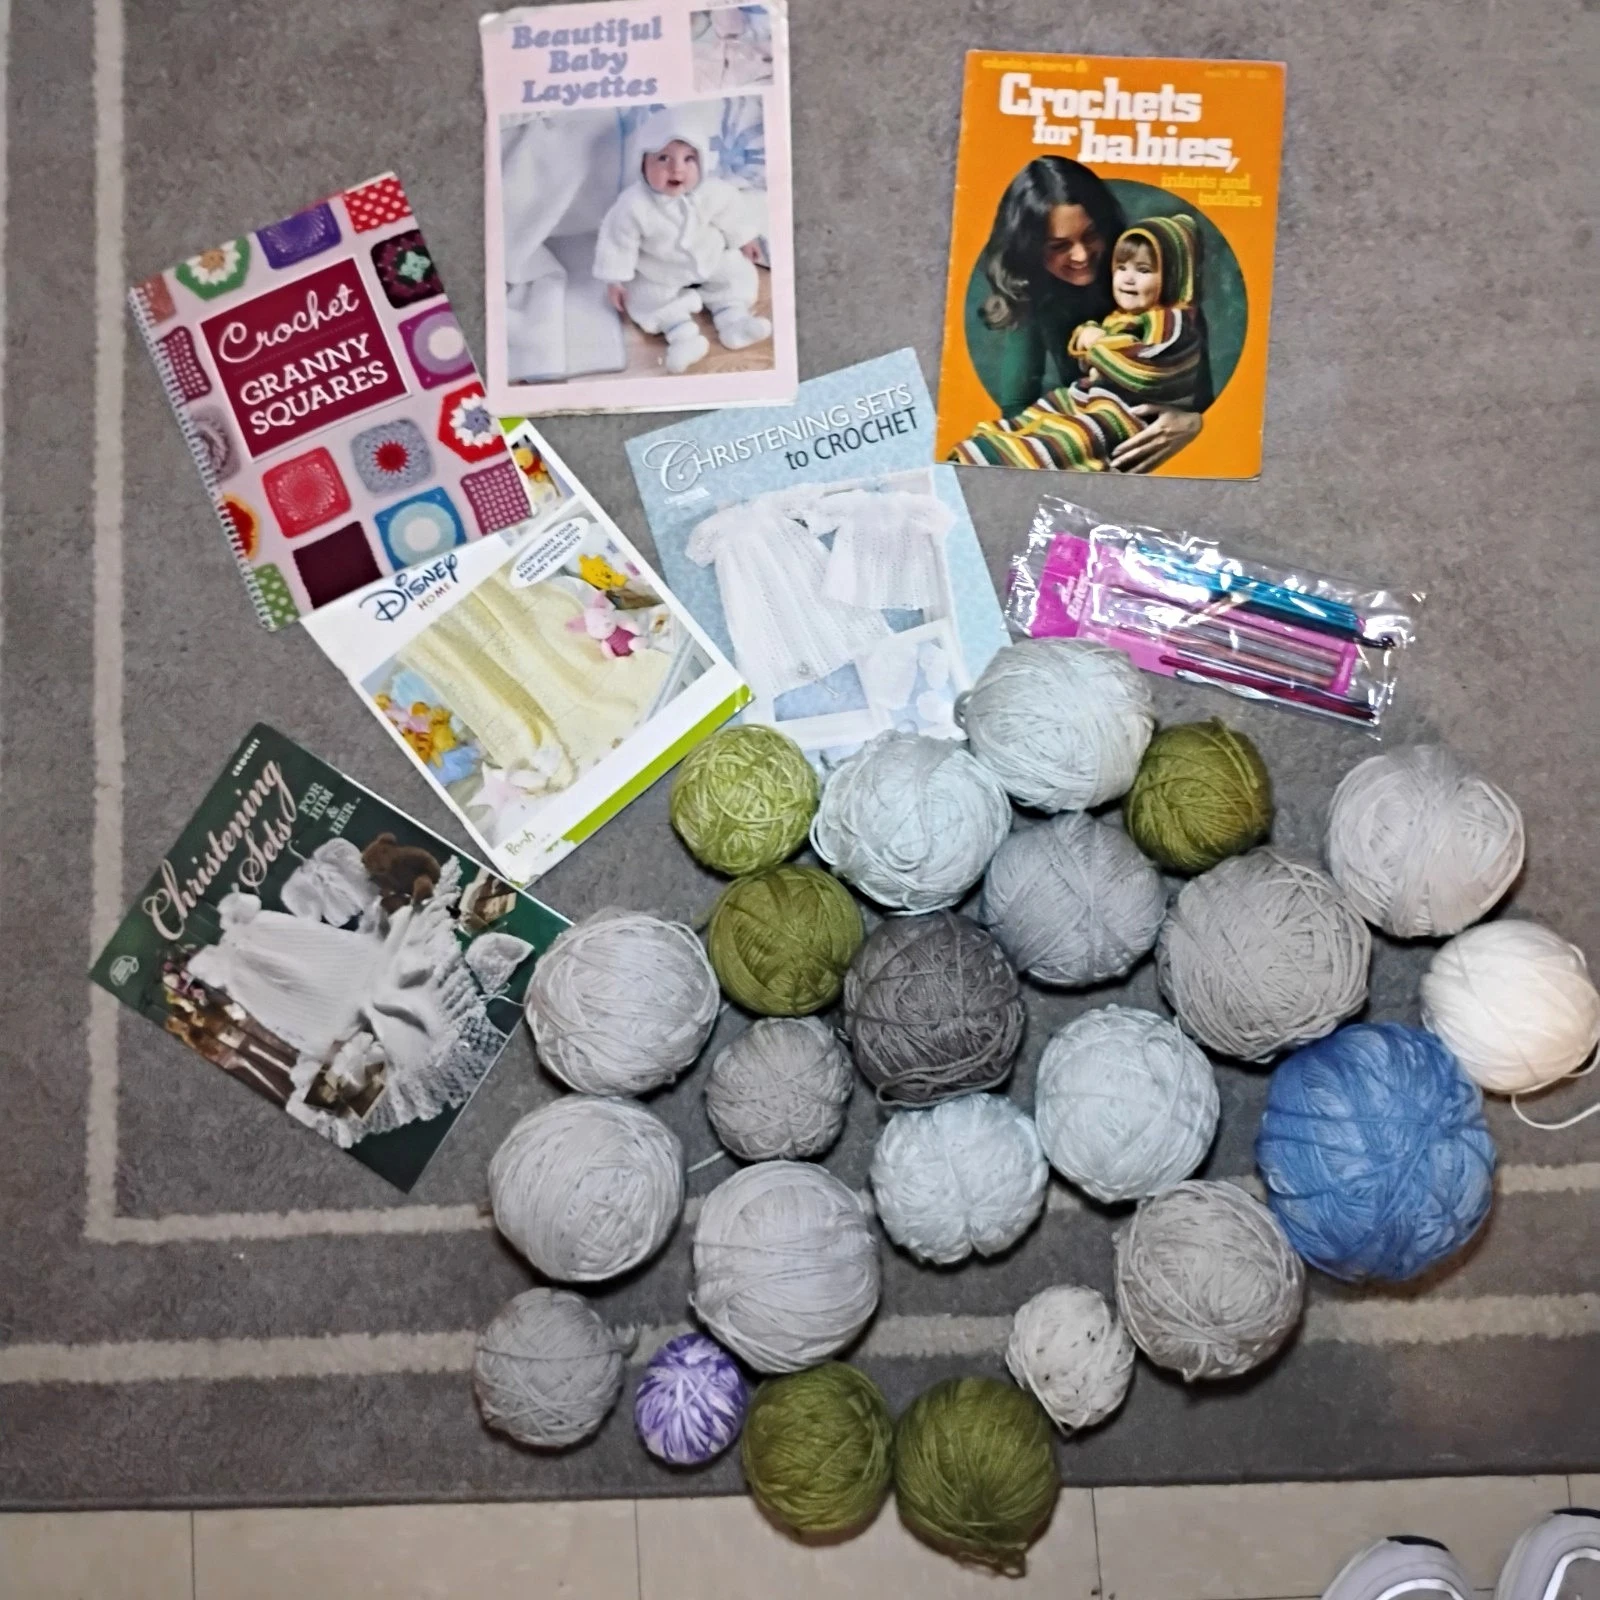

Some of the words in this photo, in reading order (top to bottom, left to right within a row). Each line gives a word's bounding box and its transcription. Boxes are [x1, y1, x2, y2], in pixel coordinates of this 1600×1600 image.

[511, 16, 662, 49] Beautiful
[548, 48, 628, 75] Baby
[521, 75, 658, 106] Layettes
[999, 72, 1202, 122] Crochets
[1032, 116, 1078, 146] for
[1077, 119, 1240, 173] babies,
[1161, 172, 1217, 188] infants
[1220, 173, 1250, 190] and
[1198, 190, 1263, 207] toddlers
[218, 283, 360, 363] Crochet
[240, 333, 371, 406] GRANNY
[249, 360, 389, 435] SQUARES
[642, 405, 850, 492] CHRISTENING
[854, 383, 913, 420] SETS
[784, 450, 809, 470] to
[813, 407, 918, 460] CROCHET
[417, 582, 452, 610] HOME
[298, 782, 323, 815] FOR
[309, 788, 334, 820] HIM
[326, 805, 340, 819] &
[329, 802, 356, 835] HER
[142, 760, 297, 940] Christening
[238, 819, 293, 888] Sets
